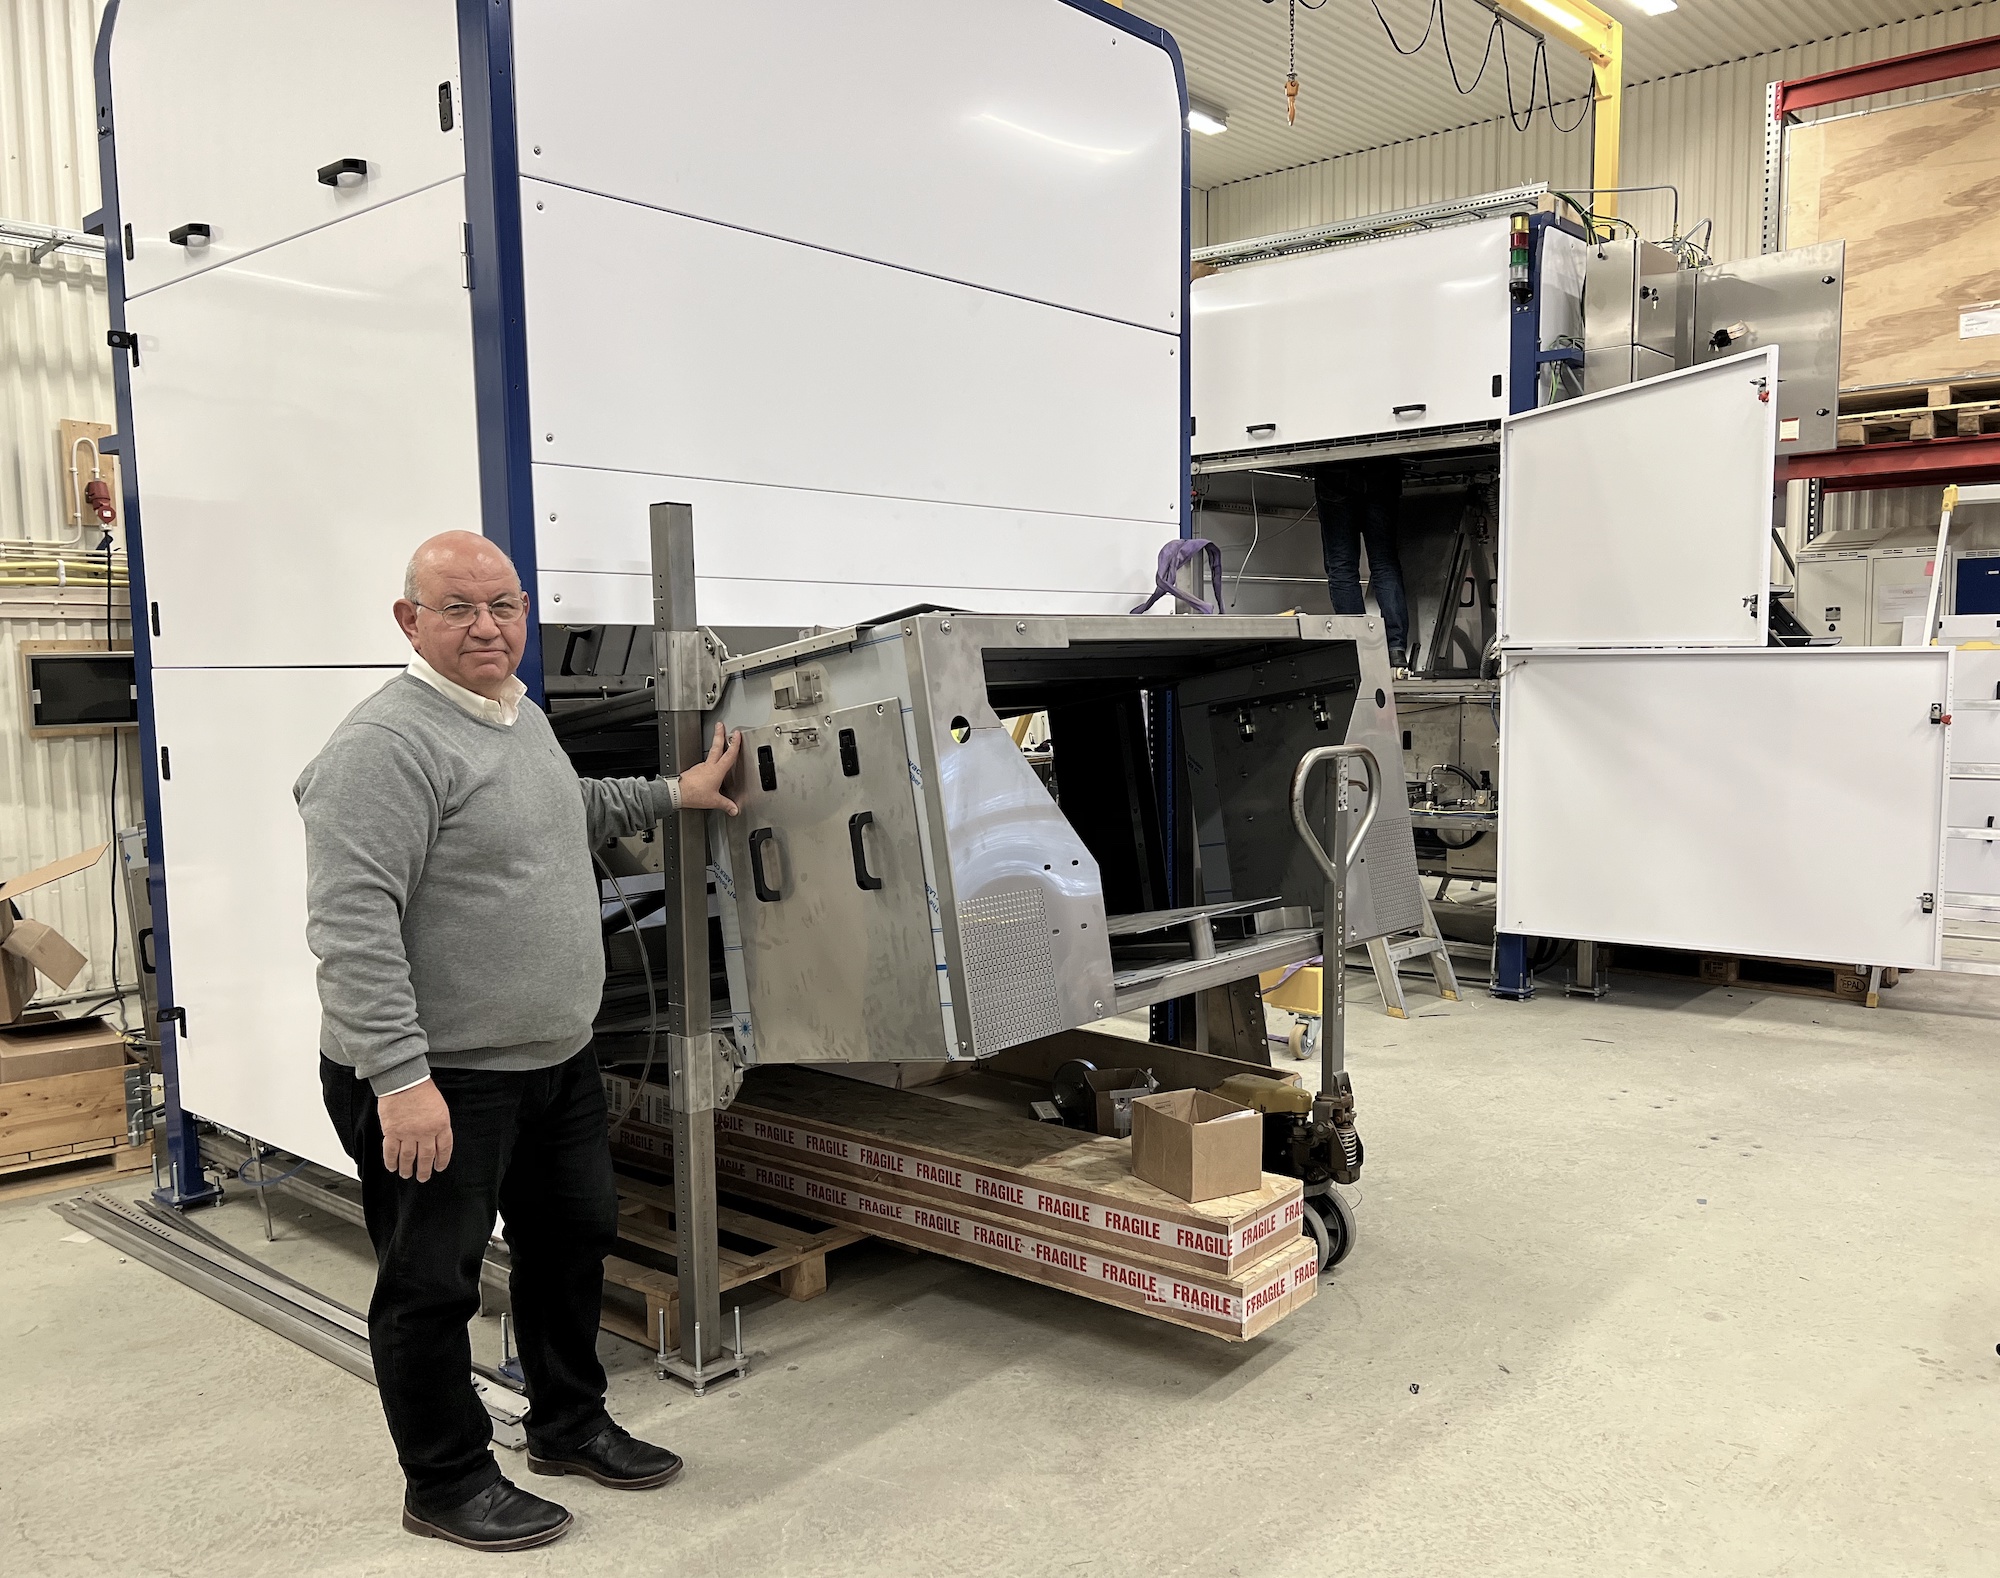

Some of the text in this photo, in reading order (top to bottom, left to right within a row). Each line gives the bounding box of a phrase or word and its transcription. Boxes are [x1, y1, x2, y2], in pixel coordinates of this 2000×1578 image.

[619, 1130, 654, 1151] FRAGILE
[756, 1168, 794, 1191] FRAGILE
[806, 1182, 847, 1206] FRAGILE
[859, 1197, 902, 1220] FRAGILE
[915, 1210, 960, 1235] FRAGILE
[974, 1226, 1022, 1253] FRAGILE
[1036, 1243, 1087, 1272] FRAGILE
[1102, 1262, 1157, 1293] FRAGILE
[1173, 1283, 1231, 1315] FRAGILE
[755, 1122, 794, 1144] FRAGILE
[806, 1135, 848, 1158] FRAGILE
[860, 1148, 903, 1172] FRAGILE
[917, 1163, 962, 1188] FRAGILE
[975, 1178, 1023, 1204] FRAGILE
[1038, 1195, 1089, 1222] FRAGILE
[1105, 1212, 1160, 1240] FRAGILE
[1177, 1229, 1233, 1257] FRAGILE
[1242, 1215, 1276, 1248] FRAGILE
